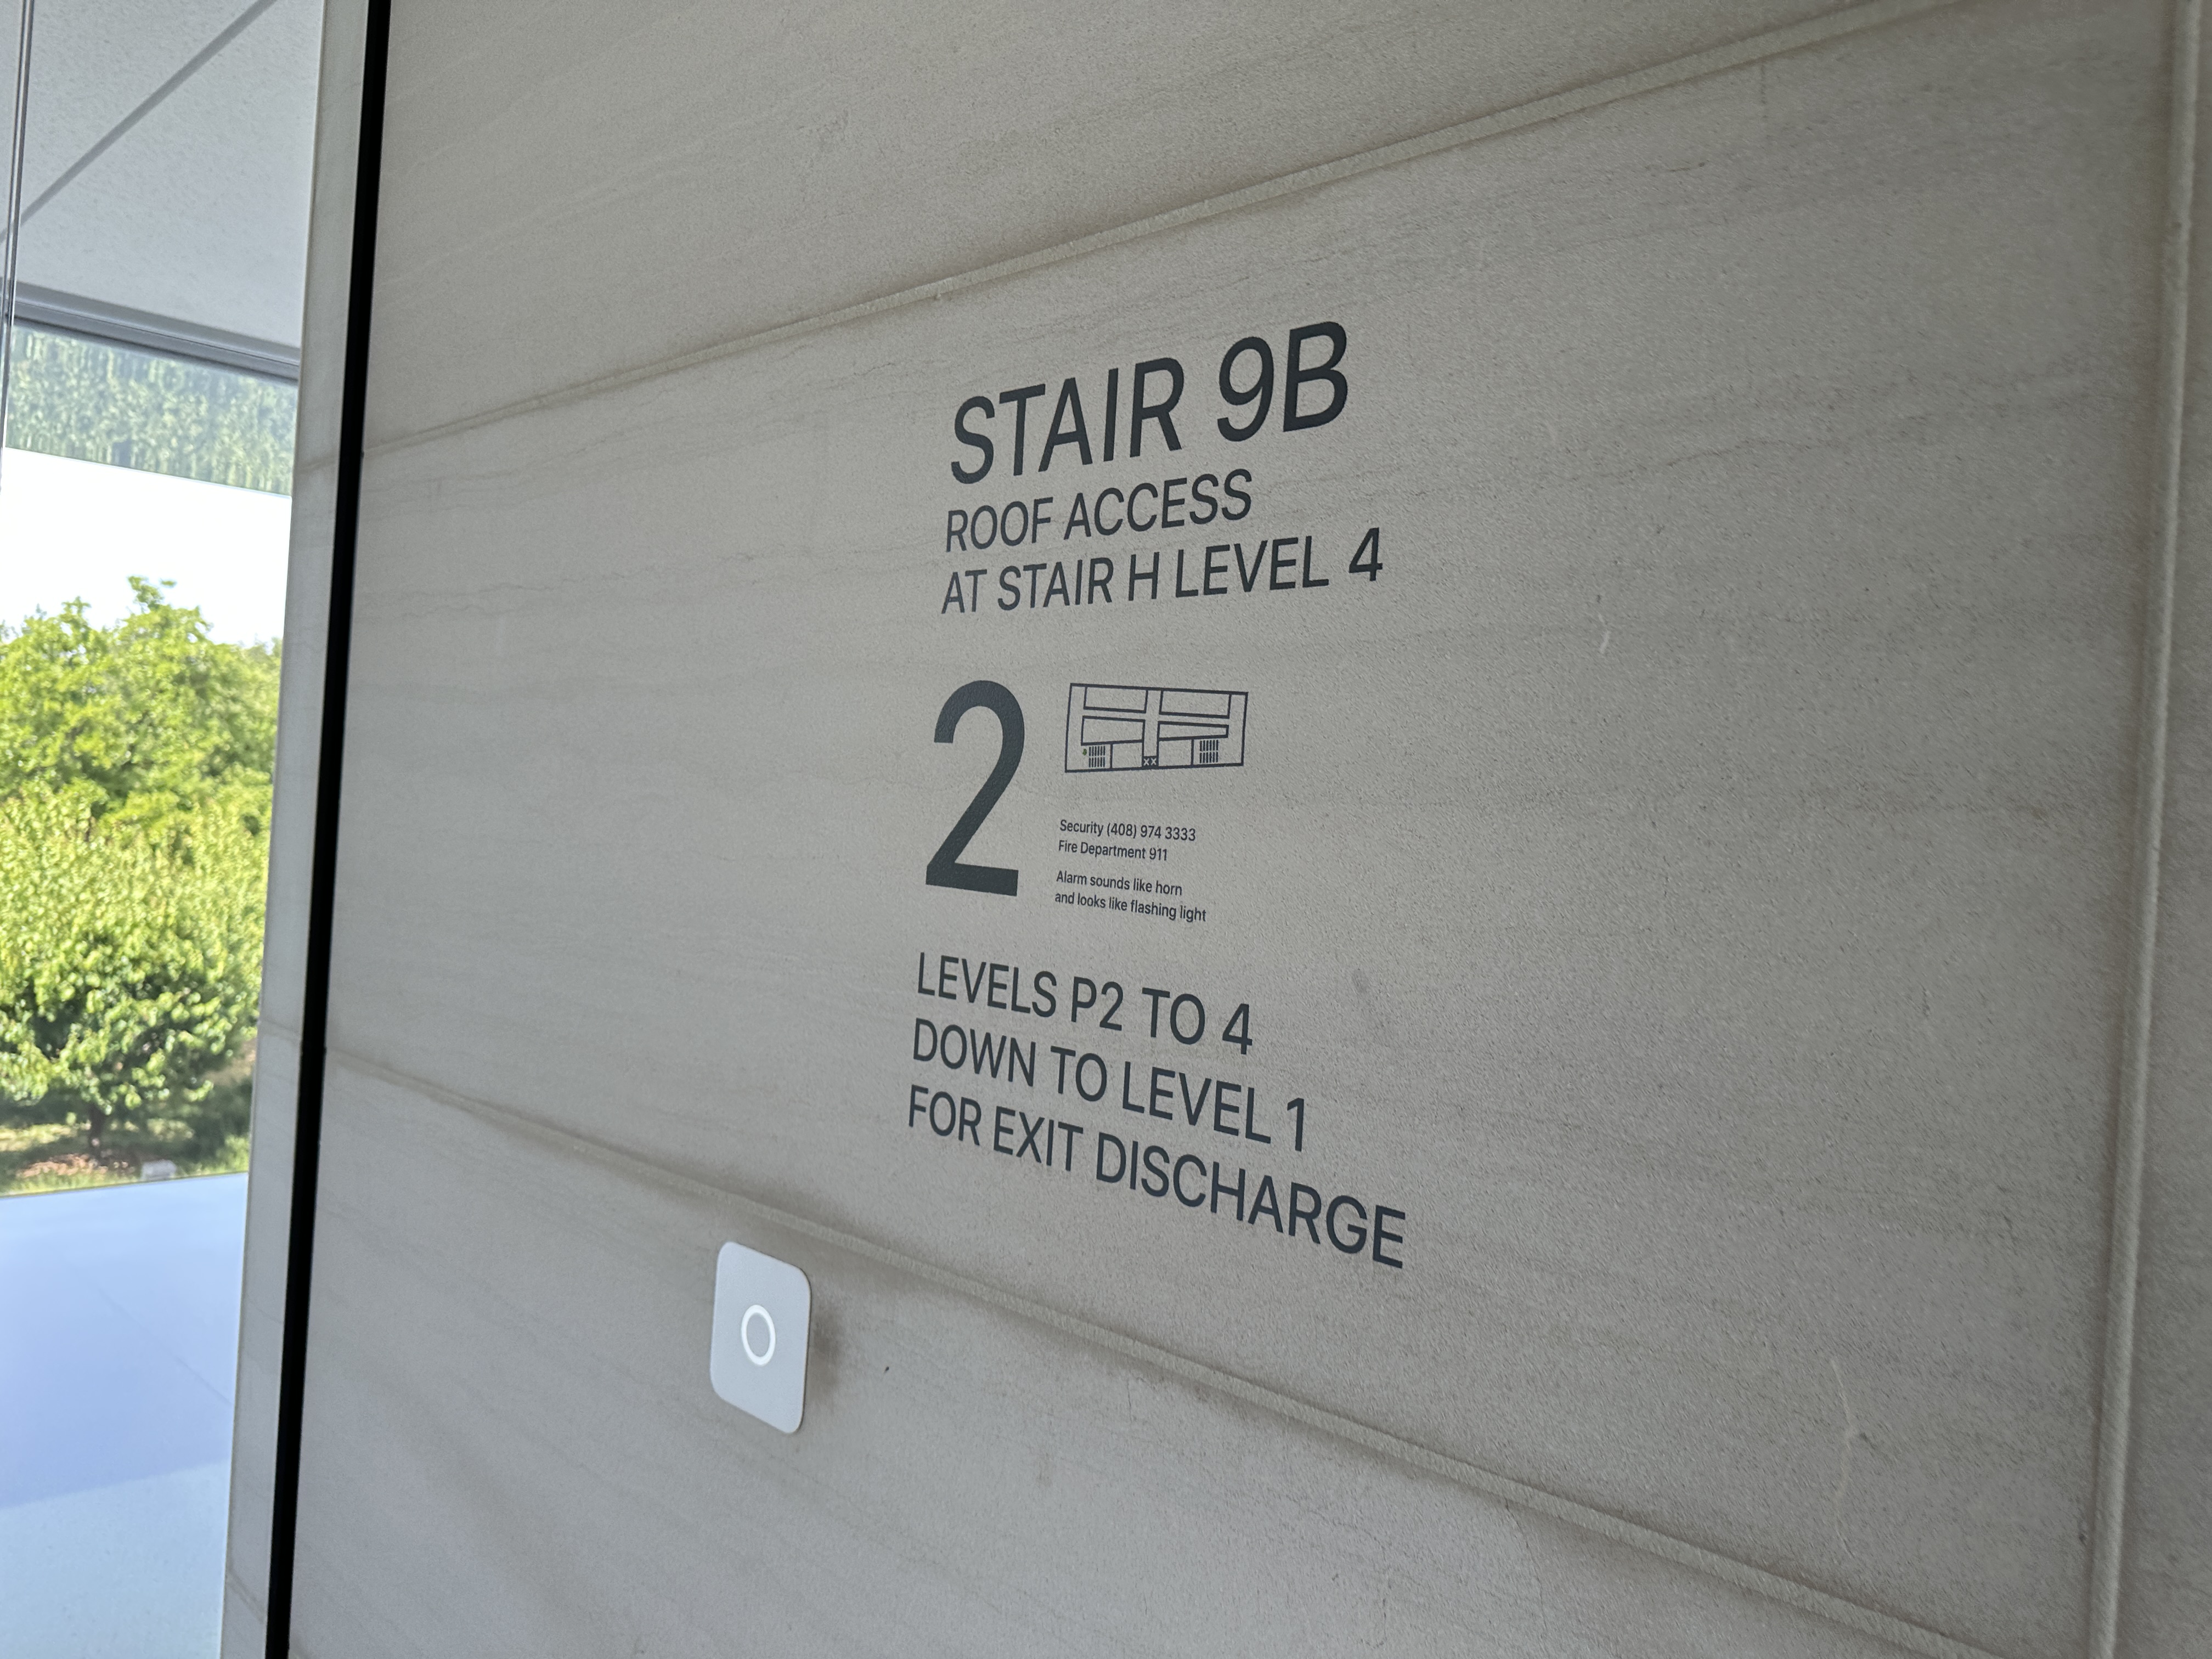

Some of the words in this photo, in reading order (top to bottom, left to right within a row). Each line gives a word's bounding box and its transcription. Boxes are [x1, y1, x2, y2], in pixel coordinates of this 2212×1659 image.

[951, 357, 1184, 484] STAIR
[1217, 321, 1348, 442] 9B
[946, 496, 1053, 552] ROOF
[1063, 468, 1252, 540] ACCESS
[941, 568, 988, 614] AT
[997, 557, 1114, 611] STAIR
[1128, 551, 1160, 601] H
[1175, 535, 1330, 599] LEVEL
[1348, 527, 1383, 582] 4
[925, 680, 1025, 897] 2
[1059, 819, 1104, 837] Security
[1107, 822, 1137, 839] (408)
[1140, 825, 1162, 839] 974
[1165, 826, 1196, 842] 3333
[1056, 870, 1087, 885] Alarm
[1090, 876, 1131, 890] sounds
[1133, 878, 1153, 893] like
[1155, 880, 1182, 896] horn
[1058, 839, 1078, 853] Fire
[1080, 842, 1146, 859] Department
[1149, 847, 1167, 861] 911
[1054, 891, 1075, 904] and
[1077, 892, 1106, 909] looks
[1109, 896, 1128, 911] like
[1130, 899, 1177, 921] flashing
[1180, 905, 1206, 923] light
[917, 952, 1057, 1018] LEVELS
[1071, 976, 1124, 1031] P2
[1142, 987, 1205, 1045] TO
[1222, 1003, 1253, 1056] 4
[913, 1017, 1036, 1087] DOWN
[1050, 1045, 1108, 1102] TO
[1122, 1060, 1272, 1144] LEVEL
[1286, 1097, 1305, 1152] 1
[909, 1084, 982, 1147] FOR
[993, 1105, 1084, 1172] EXIT
[1096, 1131, 1406, 1269] DISCHARGE
